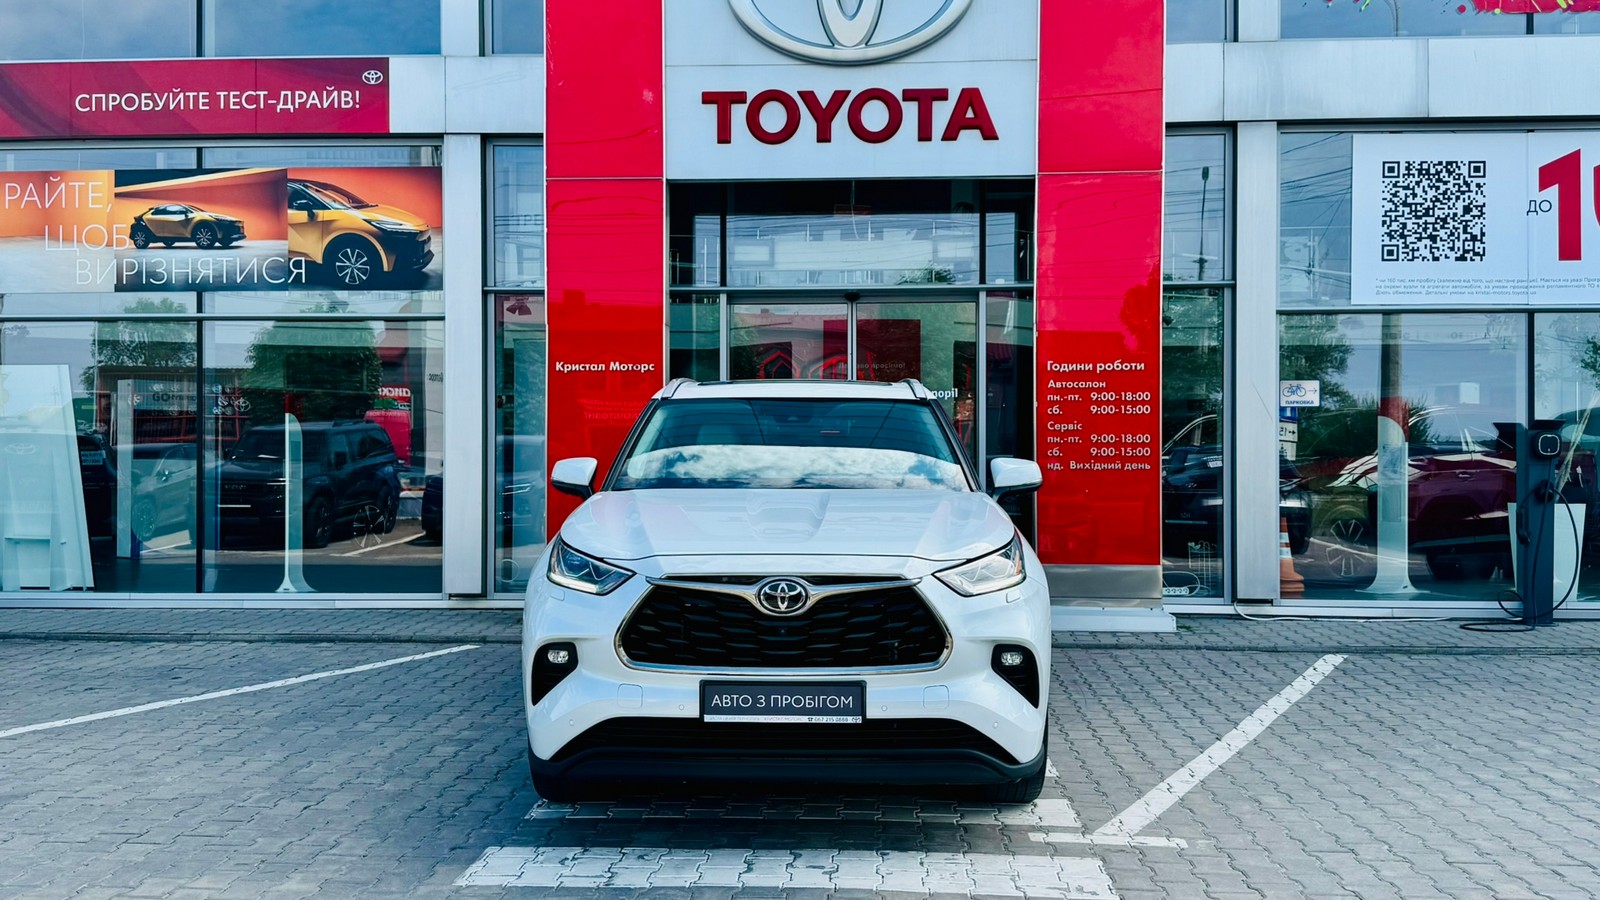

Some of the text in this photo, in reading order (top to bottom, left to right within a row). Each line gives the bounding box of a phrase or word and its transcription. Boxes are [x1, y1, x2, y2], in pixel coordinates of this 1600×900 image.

[75, 86, 360, 113] СПРОБУЙТЕ ТЕСТ-ДРАЙВ!
[702, 88, 999, 144] TOYOTA
[5, 176, 112, 212] РАЙТЕ,
[1526, 148, 1600, 261] ДО 1
[45, 224, 130, 256] ЩОБ
[75, 257, 307, 285] ВИРІЗНЯТИСЯ
[555, 361, 655, 373] Кристал Моторс
[1047, 359, 1145, 374] Години роботи
[1047, 379, 1106, 389] Автосалон
[1047, 391, 1151, 402] пн.-пт. 9:00-18:00
[1047, 404, 1151, 415] сб. 9:00-15:00
[1047, 420, 1083, 433] Сервіс
[1047, 433, 1151, 444] пн.-пт. 9:00-18:00
[1047, 447, 1151, 457] сб. 9:00-15:00
[1047, 460, 1151, 471] нд. Вихідний день
[711, 694, 853, 709] АВТО З ПРОБІГОМ
